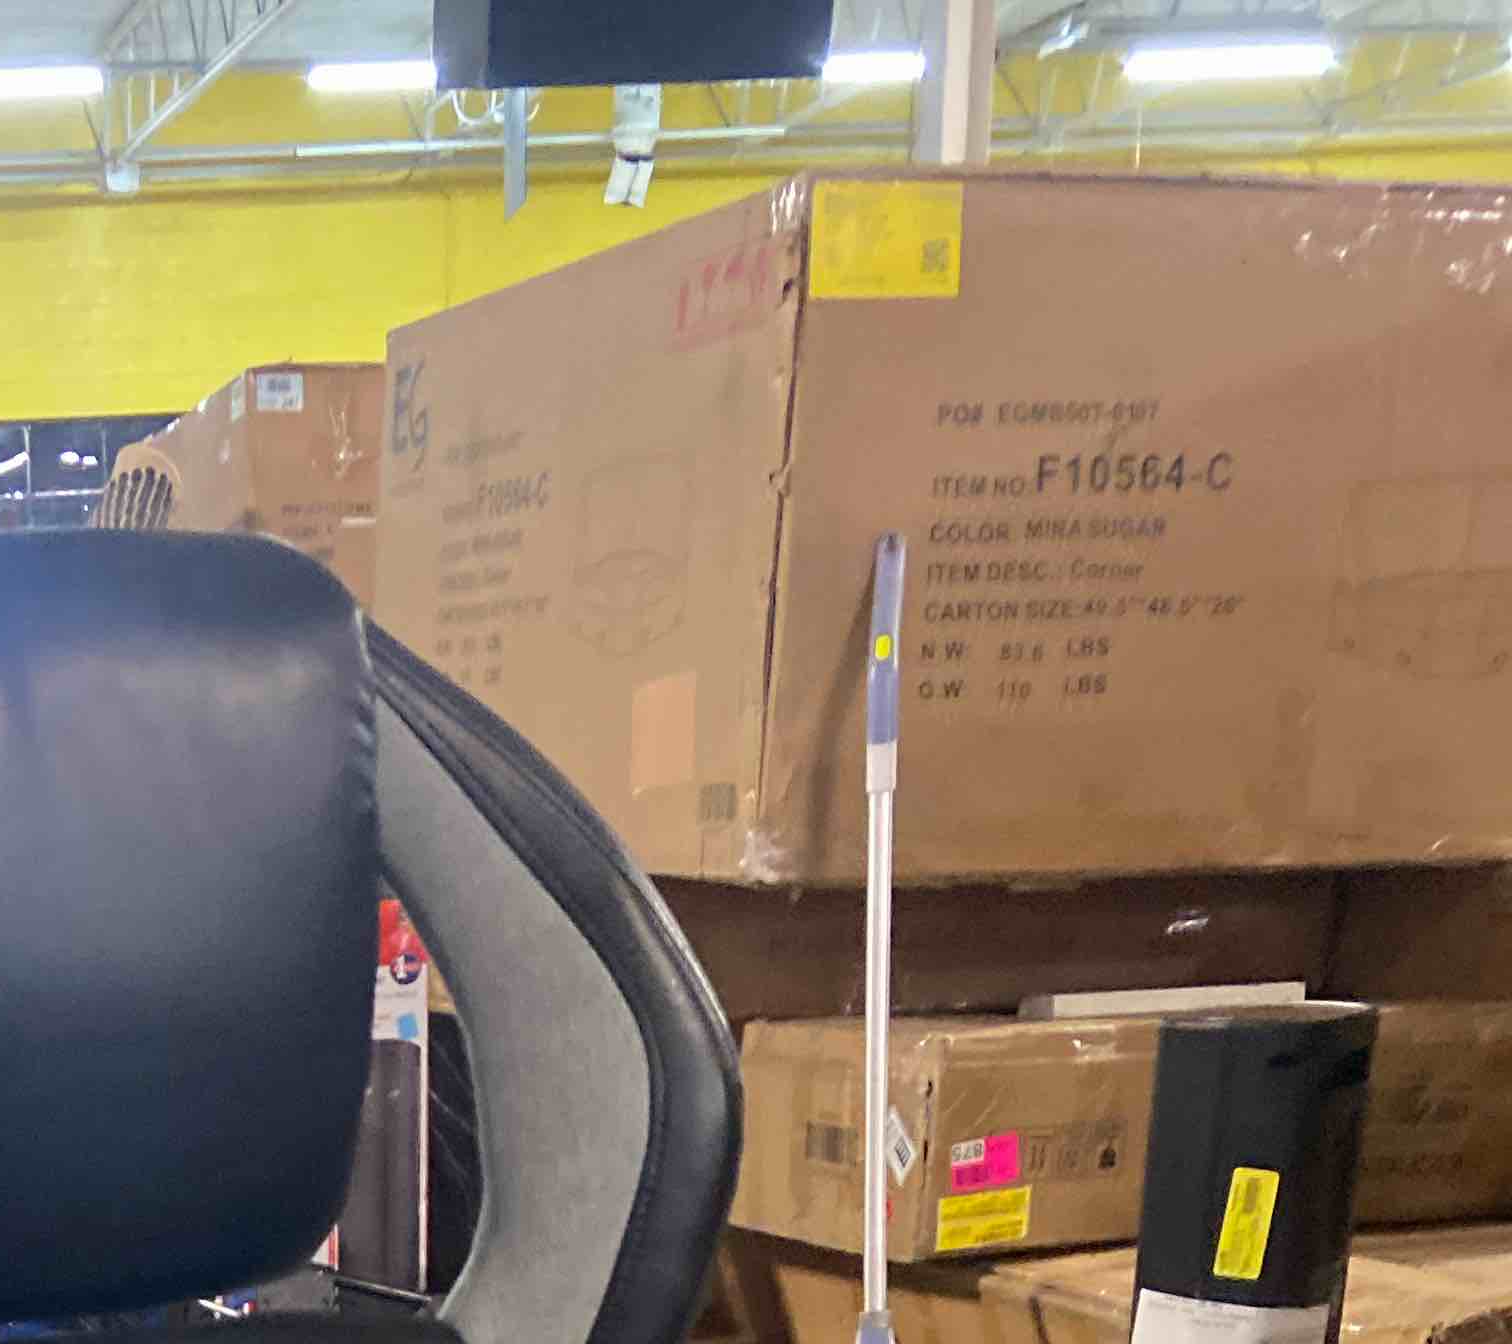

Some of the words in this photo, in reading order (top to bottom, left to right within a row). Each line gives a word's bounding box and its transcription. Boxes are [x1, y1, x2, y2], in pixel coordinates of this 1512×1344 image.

[932, 474, 987, 498] ITEM
[1037, 452, 1233, 494] F10564-C
[926, 562, 980, 588] ITEM
[923, 600, 1019, 624] CARTON
